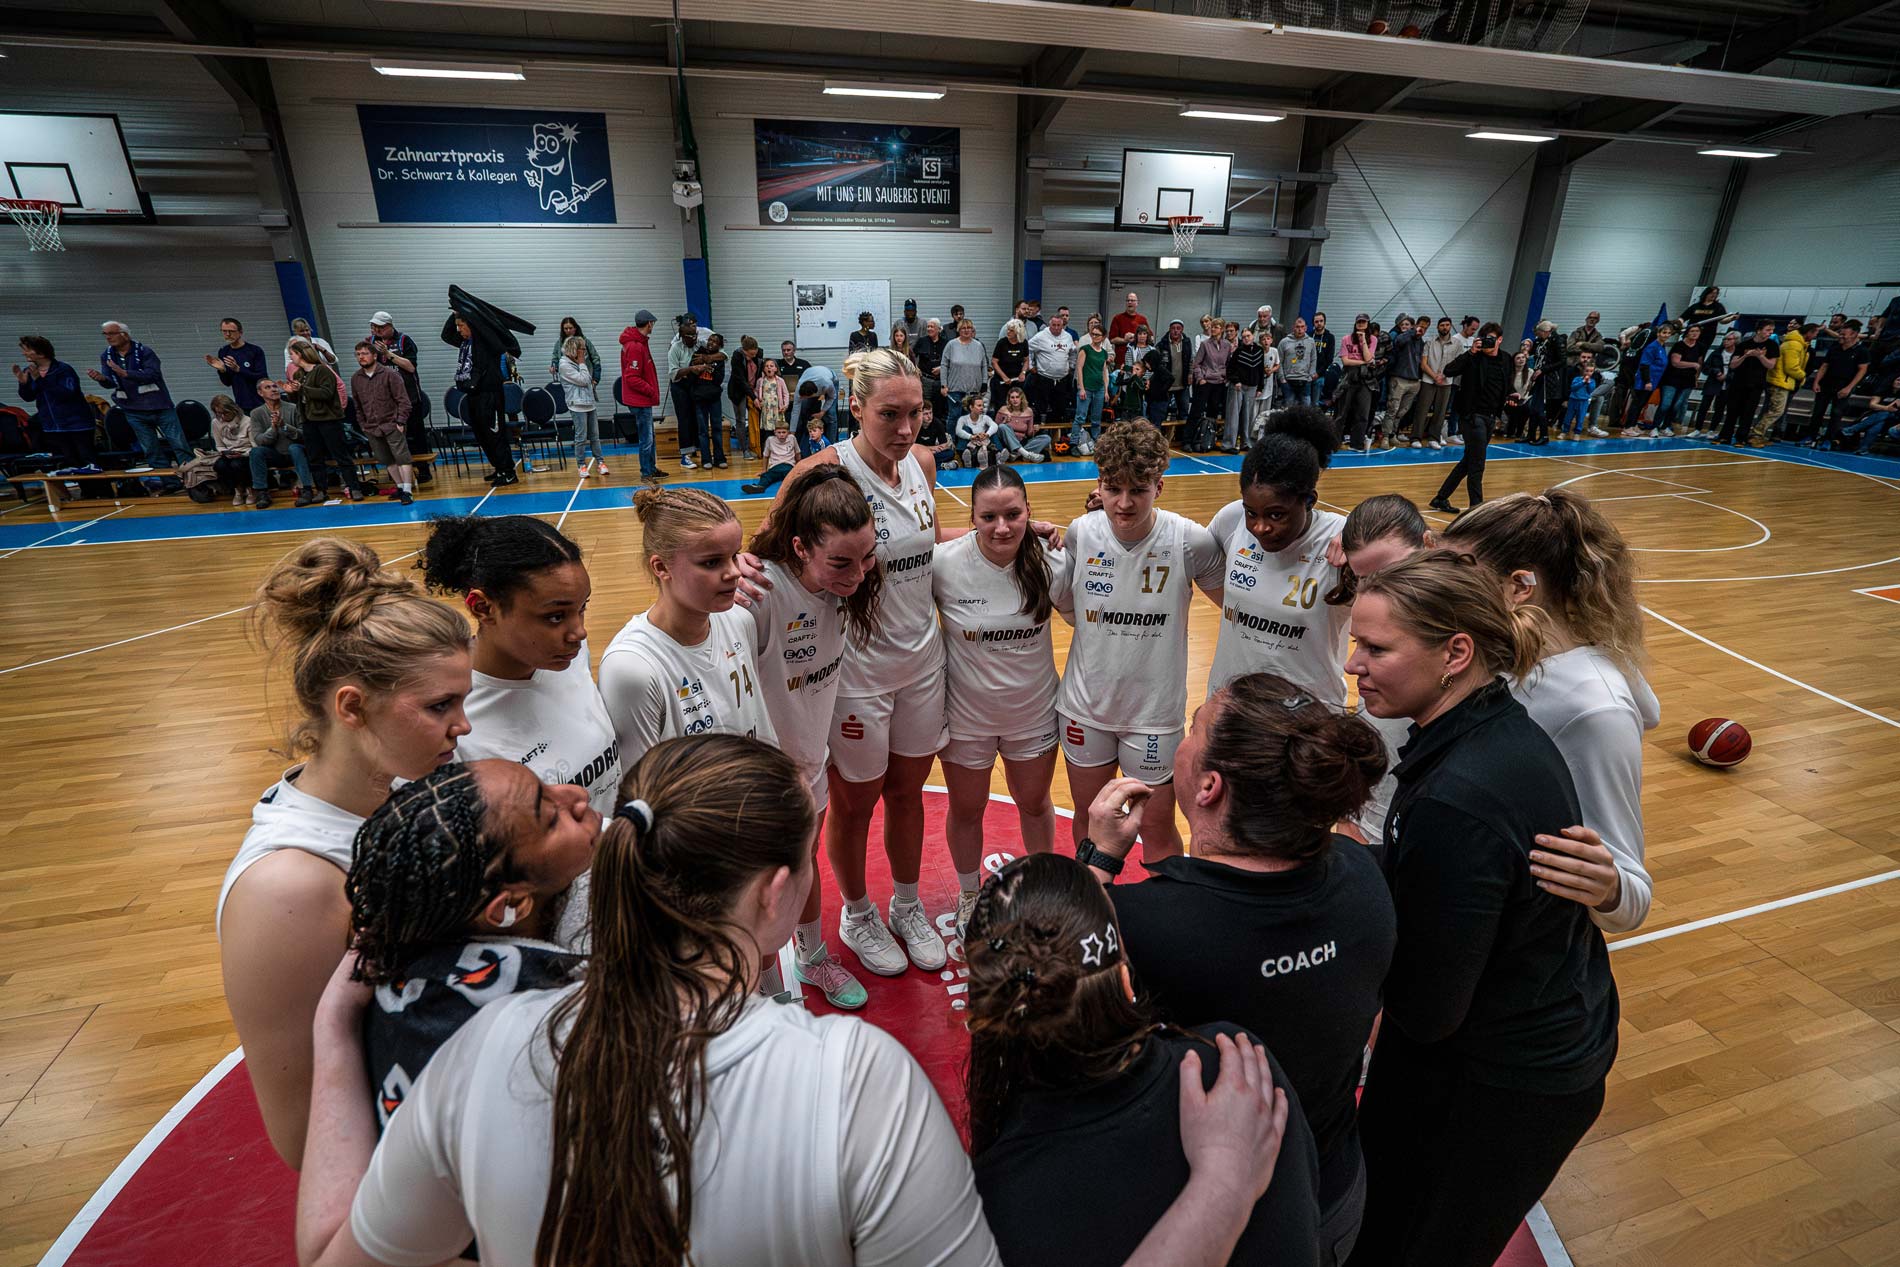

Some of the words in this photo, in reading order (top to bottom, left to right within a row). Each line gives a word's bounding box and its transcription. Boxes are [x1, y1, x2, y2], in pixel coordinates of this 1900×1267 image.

[384, 146, 505, 167] Zahnarztpraxis
[377, 167, 398, 180] Dr.
[401, 168, 453, 181] Schwarz
[456, 169, 467, 181] &
[468, 169, 518, 184] Kollegen
[816, 186, 832, 202] MIT
[835, 186, 854, 202] UNS
[857, 187, 872, 202] EIN
[875, 187, 918, 203] SAUBERES
[921, 188, 950, 204] EVENT!
[872, 500, 885, 511] asi
[914, 499, 934, 532] 13
[1102, 557, 1114, 568] asi
[1251, 551, 1264, 562] asi
[1234, 560, 1253, 571] CRAFT
[1088, 570, 1109, 579] CRAFT
[1141, 566, 1170, 594] 17
[1230, 570, 1256, 587] EAG
[1085, 580, 1113, 594] EAG
[1282, 575, 1318, 610] 20
[803, 616, 817, 628] asi
[788, 634, 811, 643] CRAFT
[784, 646, 816, 660] EAG
[690, 679, 703, 694] si
[730, 664, 753, 709] 74
[518, 747, 538, 765] AFT
[1261, 940, 1336, 978] COACH
